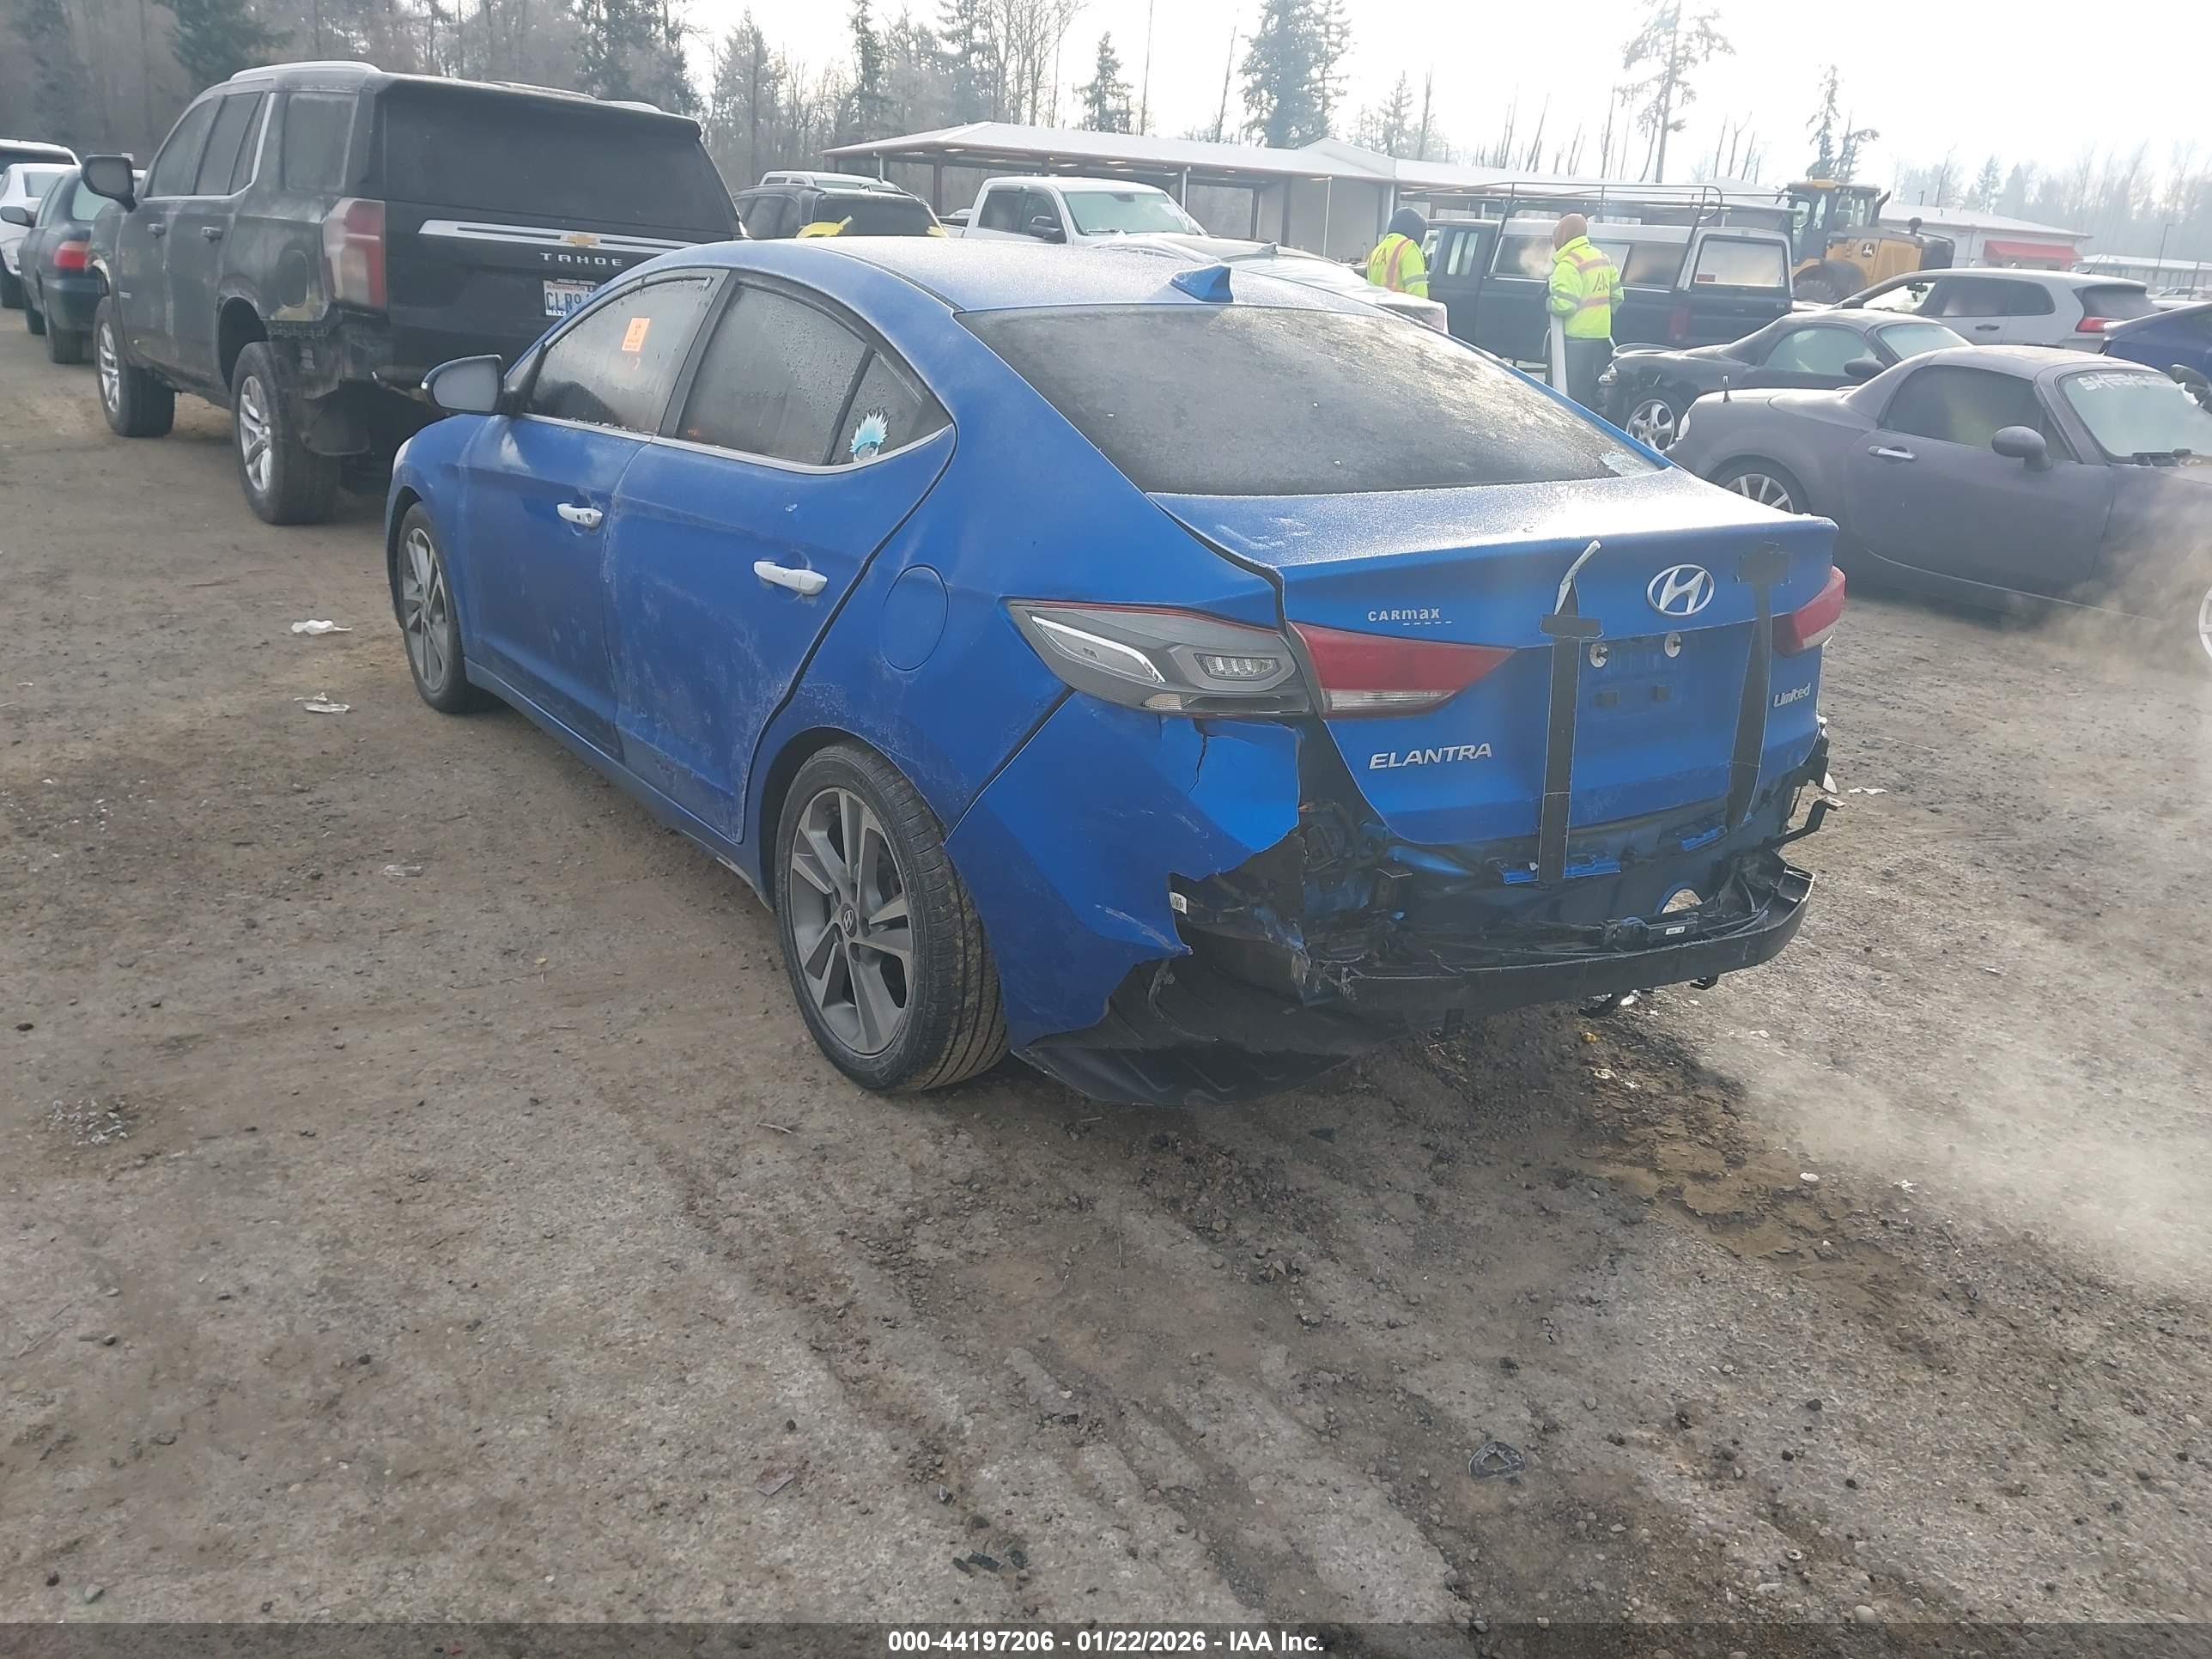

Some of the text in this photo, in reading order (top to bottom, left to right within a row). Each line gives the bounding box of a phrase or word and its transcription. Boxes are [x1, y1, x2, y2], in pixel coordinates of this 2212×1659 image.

[539, 252, 623, 266] TAHOE
[1773, 682, 1811, 708] Limited
[1369, 742, 1492, 770] ELANTRA
